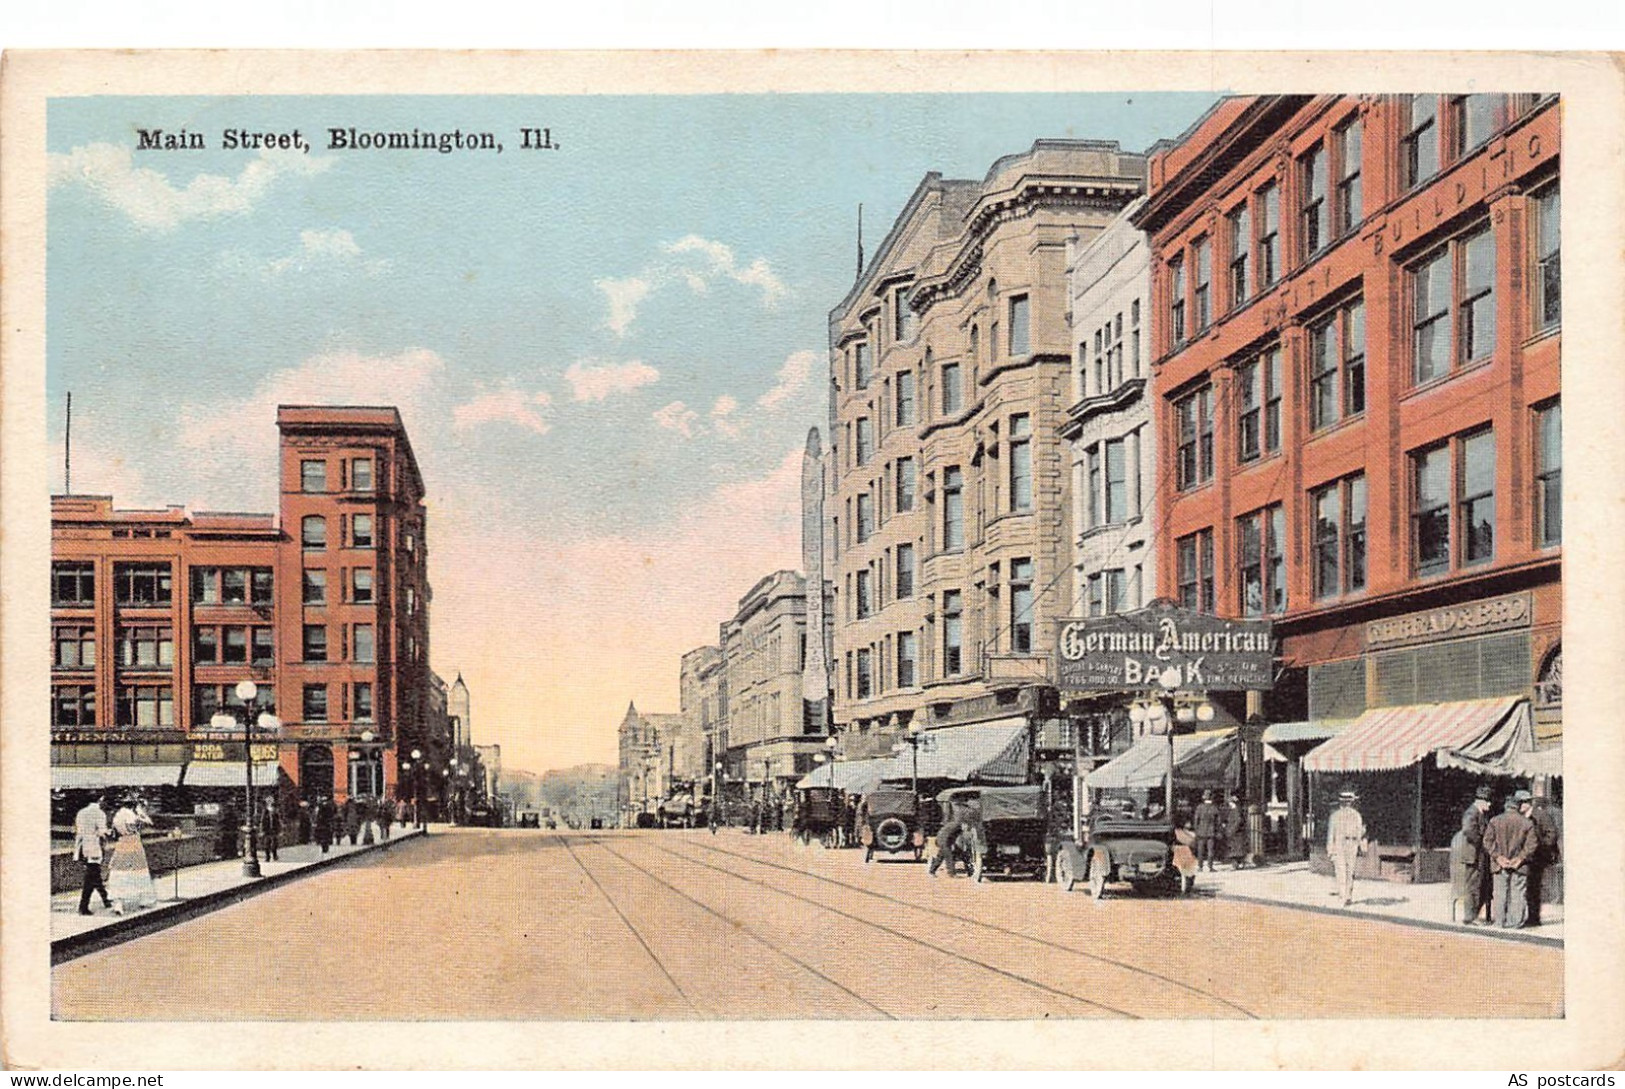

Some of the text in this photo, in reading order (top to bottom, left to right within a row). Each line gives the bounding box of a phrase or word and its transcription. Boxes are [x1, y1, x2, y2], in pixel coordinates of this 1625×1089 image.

[1373, 134, 1541, 256] BUILDING
[1060, 617, 1270, 661] German American
